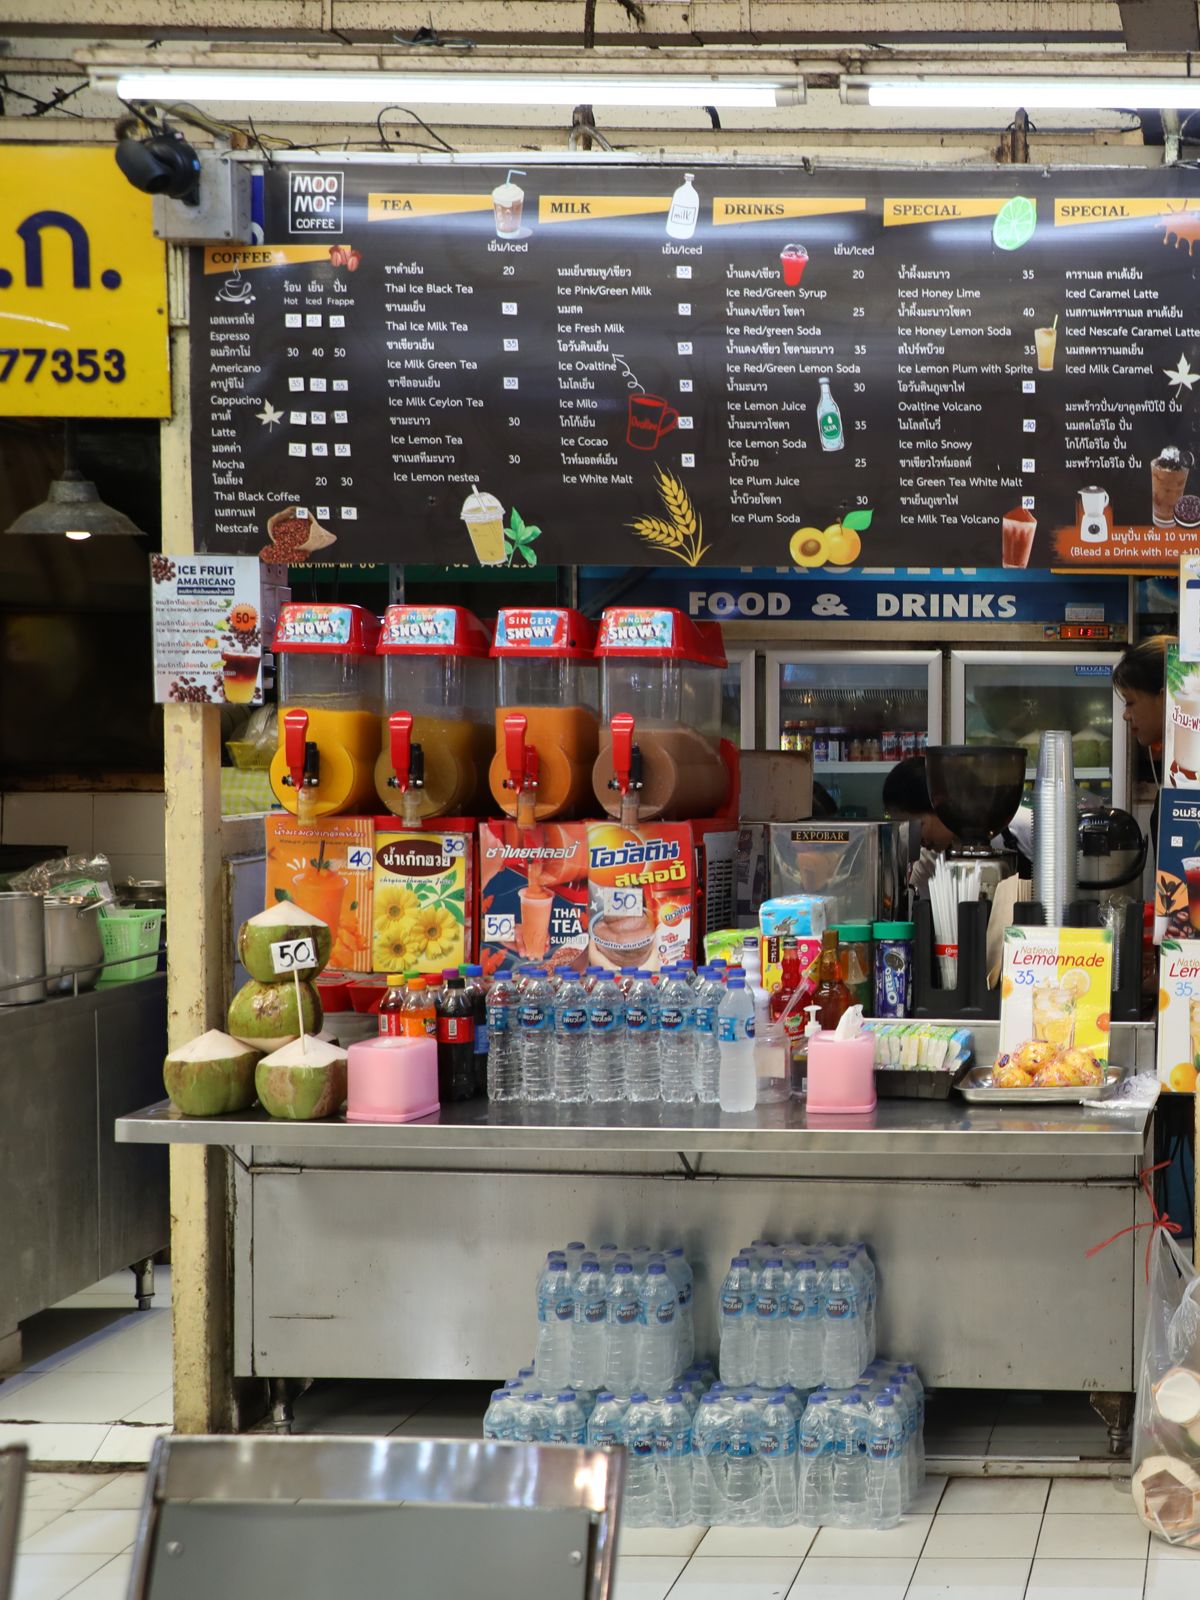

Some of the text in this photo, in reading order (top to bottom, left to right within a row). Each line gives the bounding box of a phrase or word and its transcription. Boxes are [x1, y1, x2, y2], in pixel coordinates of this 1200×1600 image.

[293, 176, 338, 193] MOO
[293, 195, 337, 213] MOF
[380, 199, 414, 212] TEA
[550, 202, 592, 214] MILK
[723, 203, 786, 216] DRINKS
[892, 205, 962, 217] SPECIAL
[1060, 205, 1130, 218] SPECIAL
[295, 218, 335, 230] COFFEE
[210, 252, 272, 264] COFFEE
[1065, 288, 1159, 299] Iced Caramel Latte
[209, 331, 251, 344] Espresso
[0, 349, 126, 384] 77353
[209, 363, 262, 374] Americano
[210, 393, 262, 406] Cappucino
[211, 427, 237, 438] Latte
[212, 459, 245, 470] Mocha
[215, 523, 259, 534] Nestcafe
[178, 565, 234, 576] ICE FRUIT
[176, 577, 236, 586] AMARICANO
[688, 591, 1017, 618] FOOD & DRINKS
[508, 616, 553, 625] SINGER
[284, 620, 341, 637] SNOWY
[390, 621, 446, 638] SNOWY
[505, 626, 557, 640] SNOWY
[608, 623, 663, 640] SNOWY
[795, 831, 845, 841] EXPOBAR
[442, 839, 465, 854] 30
[382, 847, 451, 867] น้ำเก๊กฮวย
[589, 840, 680, 869] โอวัลติน
[612, 891, 637, 911] 50
[553, 908, 582, 918] THAI
[551, 920, 583, 934] TEA
[1012, 950, 1105, 968] Lemonnade
[884, 967, 899, 1005] OREO
